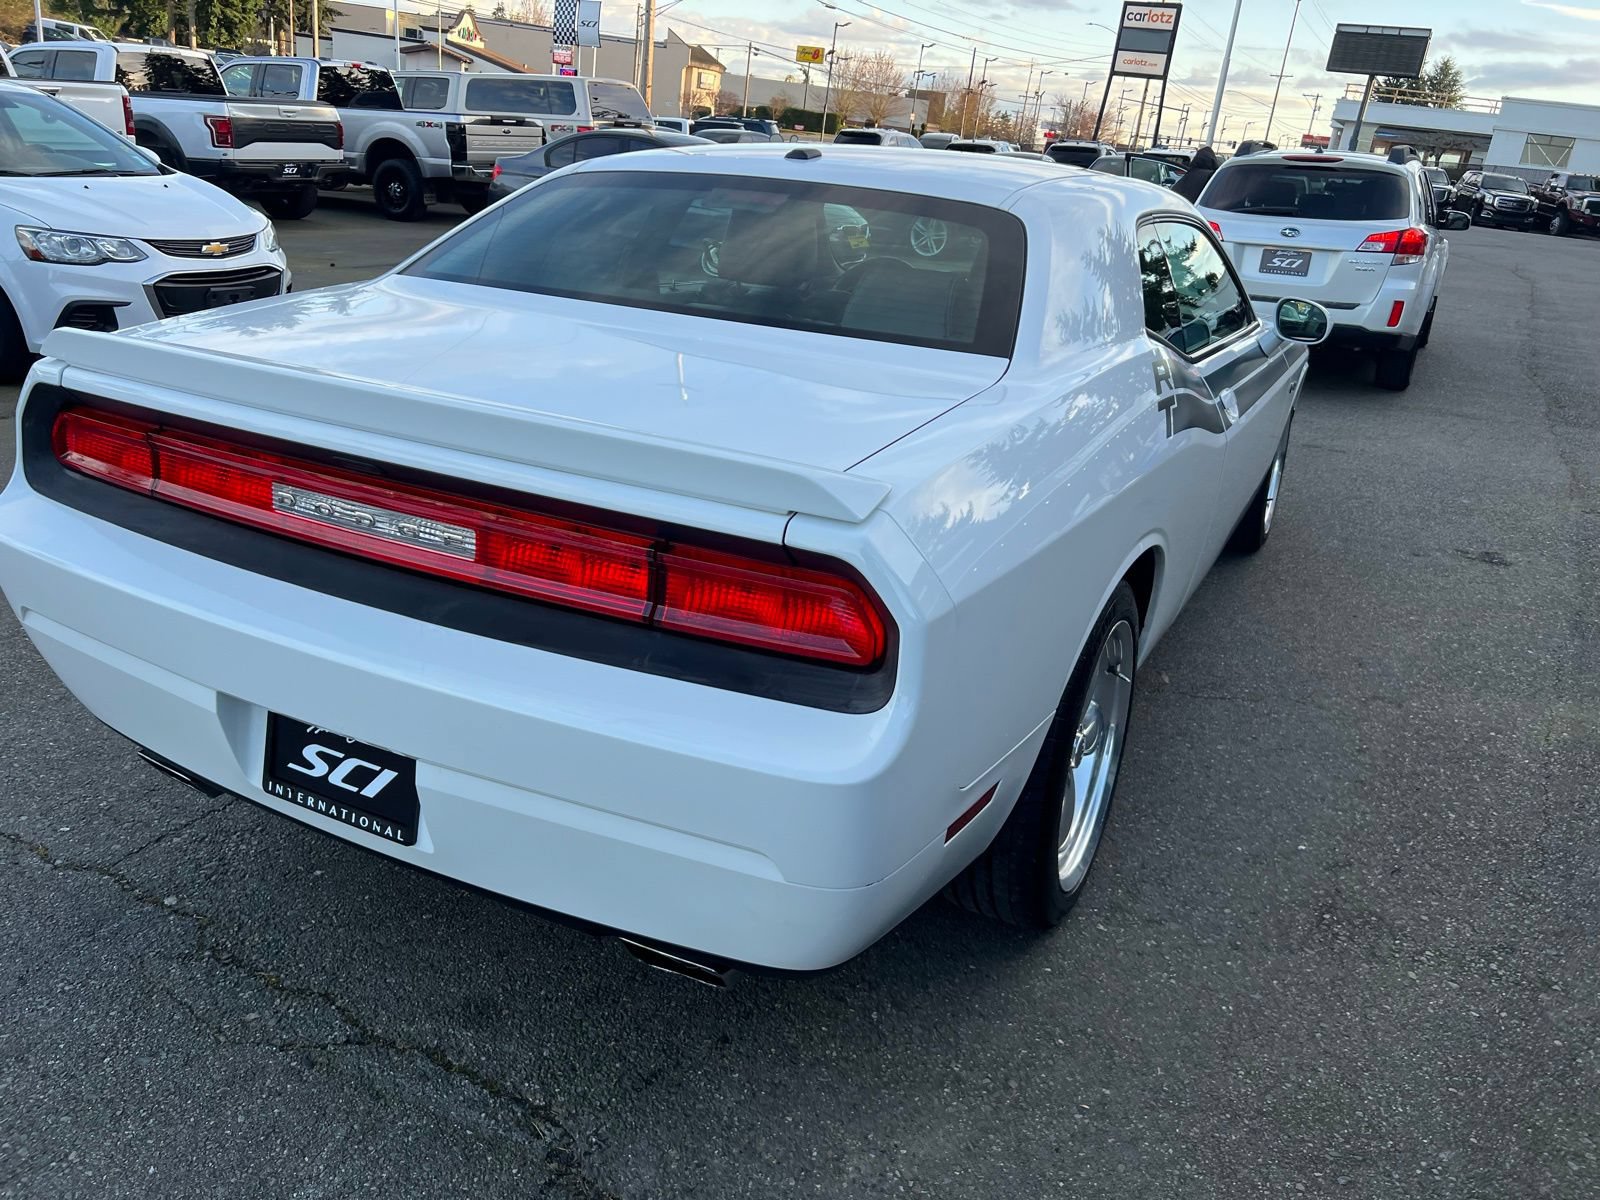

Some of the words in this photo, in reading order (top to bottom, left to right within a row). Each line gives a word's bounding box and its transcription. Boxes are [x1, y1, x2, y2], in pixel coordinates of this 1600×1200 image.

[579, 20, 598, 28] SCI
[1126, 9, 1173, 24] carlotz
[1267, 257, 1304, 268] SCI
[277, 491, 465, 547] DODGE
[286, 743, 399, 799] SCI
[268, 781, 405, 842] INTERNATIONAL
